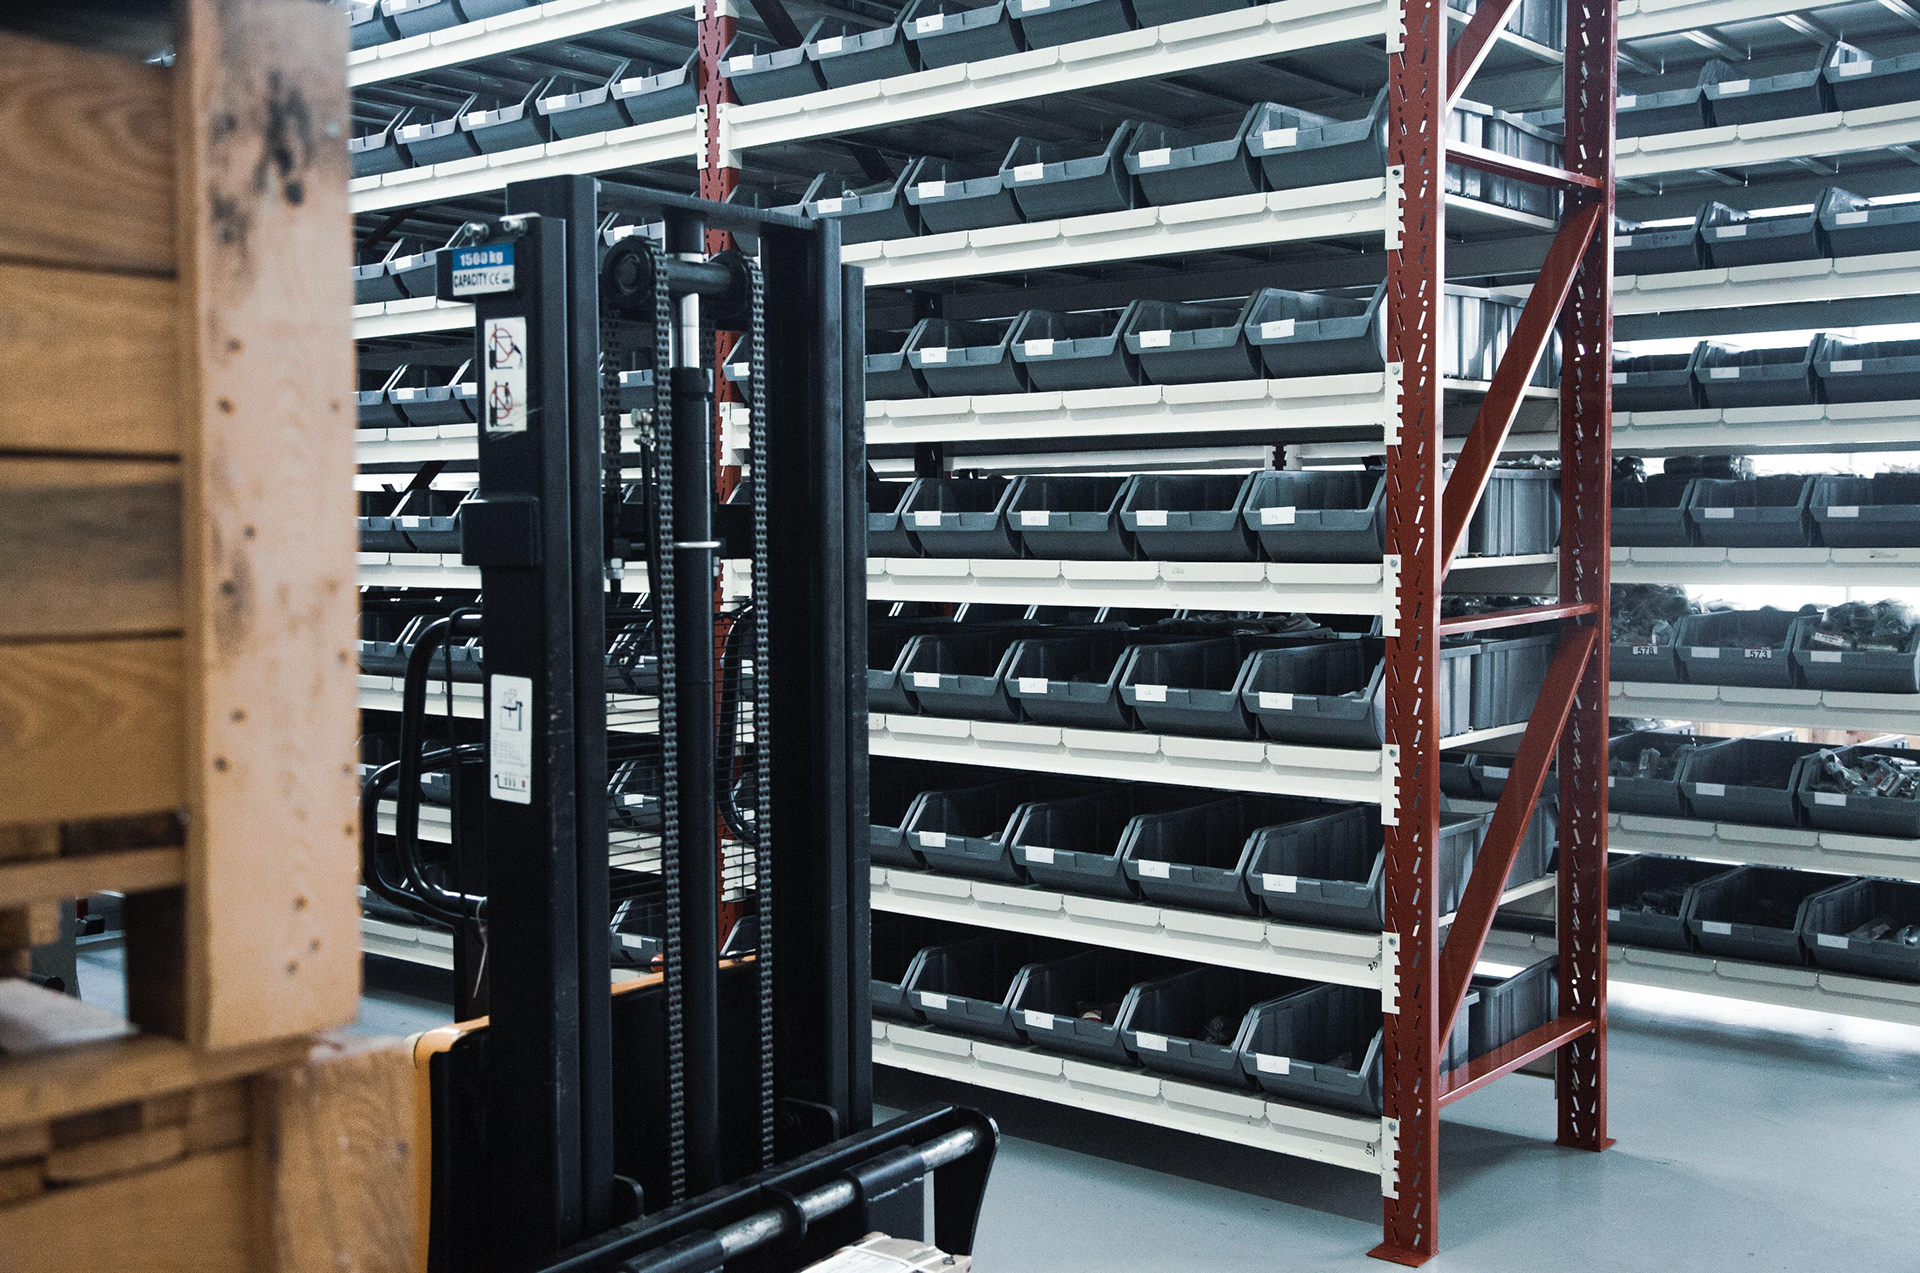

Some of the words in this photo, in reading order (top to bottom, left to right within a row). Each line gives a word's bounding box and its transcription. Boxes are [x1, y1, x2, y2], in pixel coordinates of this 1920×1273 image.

[460, 251, 488, 267] 1500
[489, 250, 504, 265] kg
[454, 272, 487, 288] CAPACITY
[1637, 646, 1655, 656] 578
[1749, 650, 1768, 659] 573
